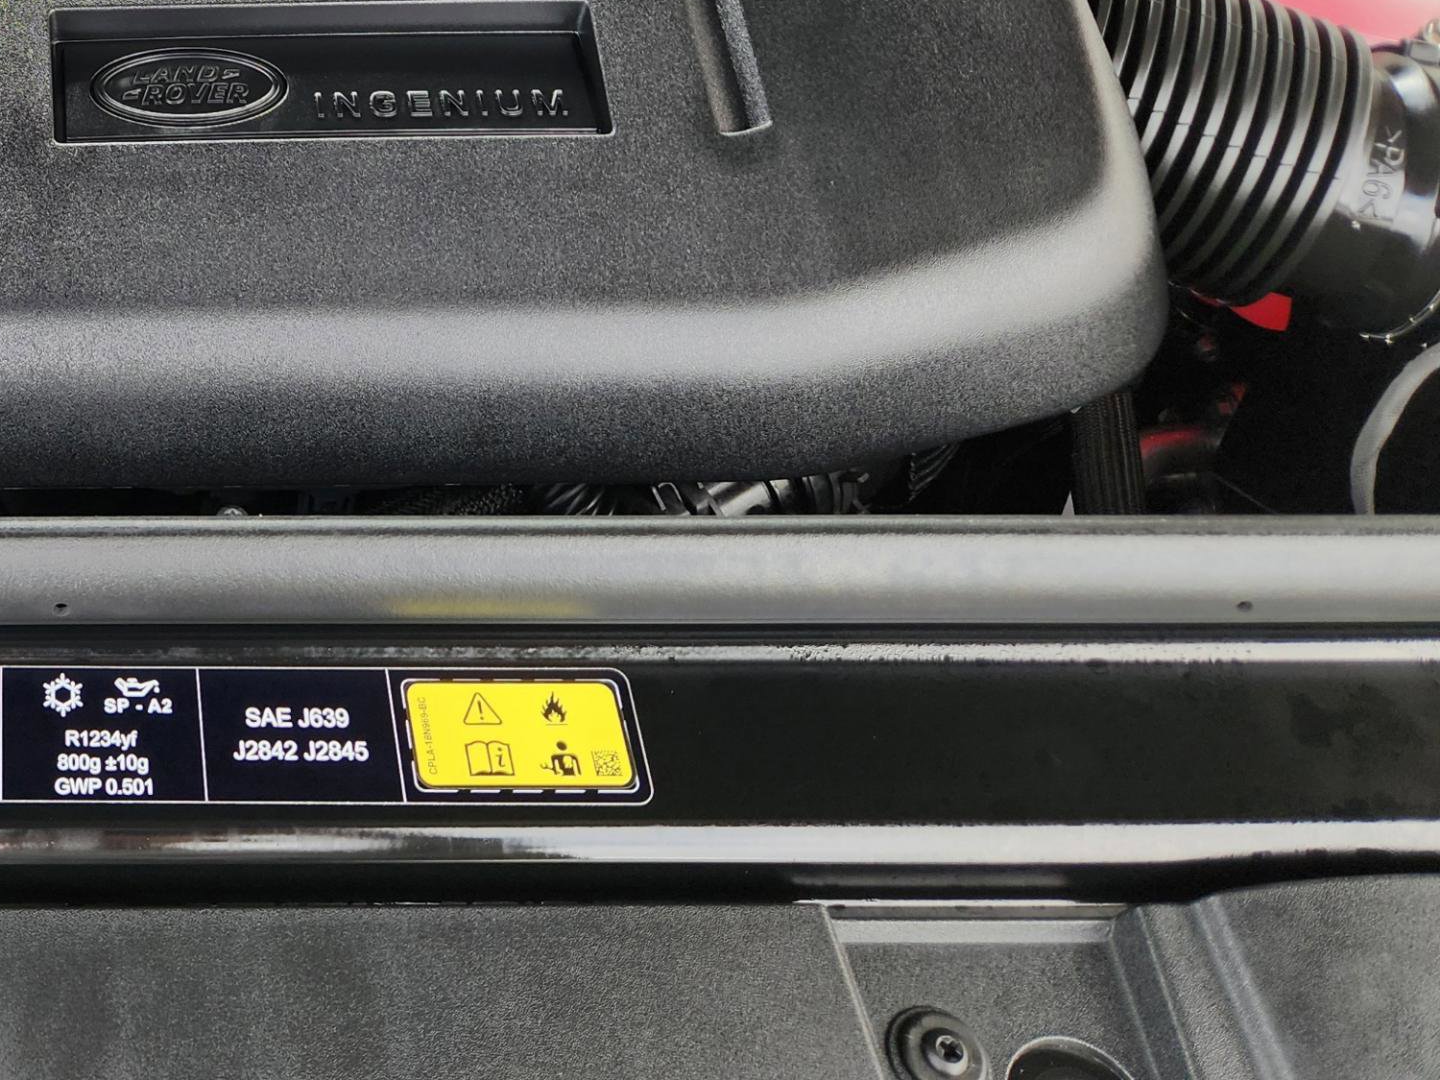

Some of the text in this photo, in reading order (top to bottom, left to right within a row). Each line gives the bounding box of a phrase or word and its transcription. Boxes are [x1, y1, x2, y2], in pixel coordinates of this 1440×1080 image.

[132, 65, 220, 85] LAND
[141, 82, 250, 106] ROVER
[313, 88, 570, 118] INGENIUM
[103, 697, 130, 714] SP
[147, 697, 173, 714] A2
[244, 706, 350, 728] SAE J639
[64, 729, 138, 751] R1234yf
[233, 739, 370, 762] J2842 J2845
[56, 753, 150, 775] 800g ±10g
[54, 777, 153, 796] GWP 0.501
